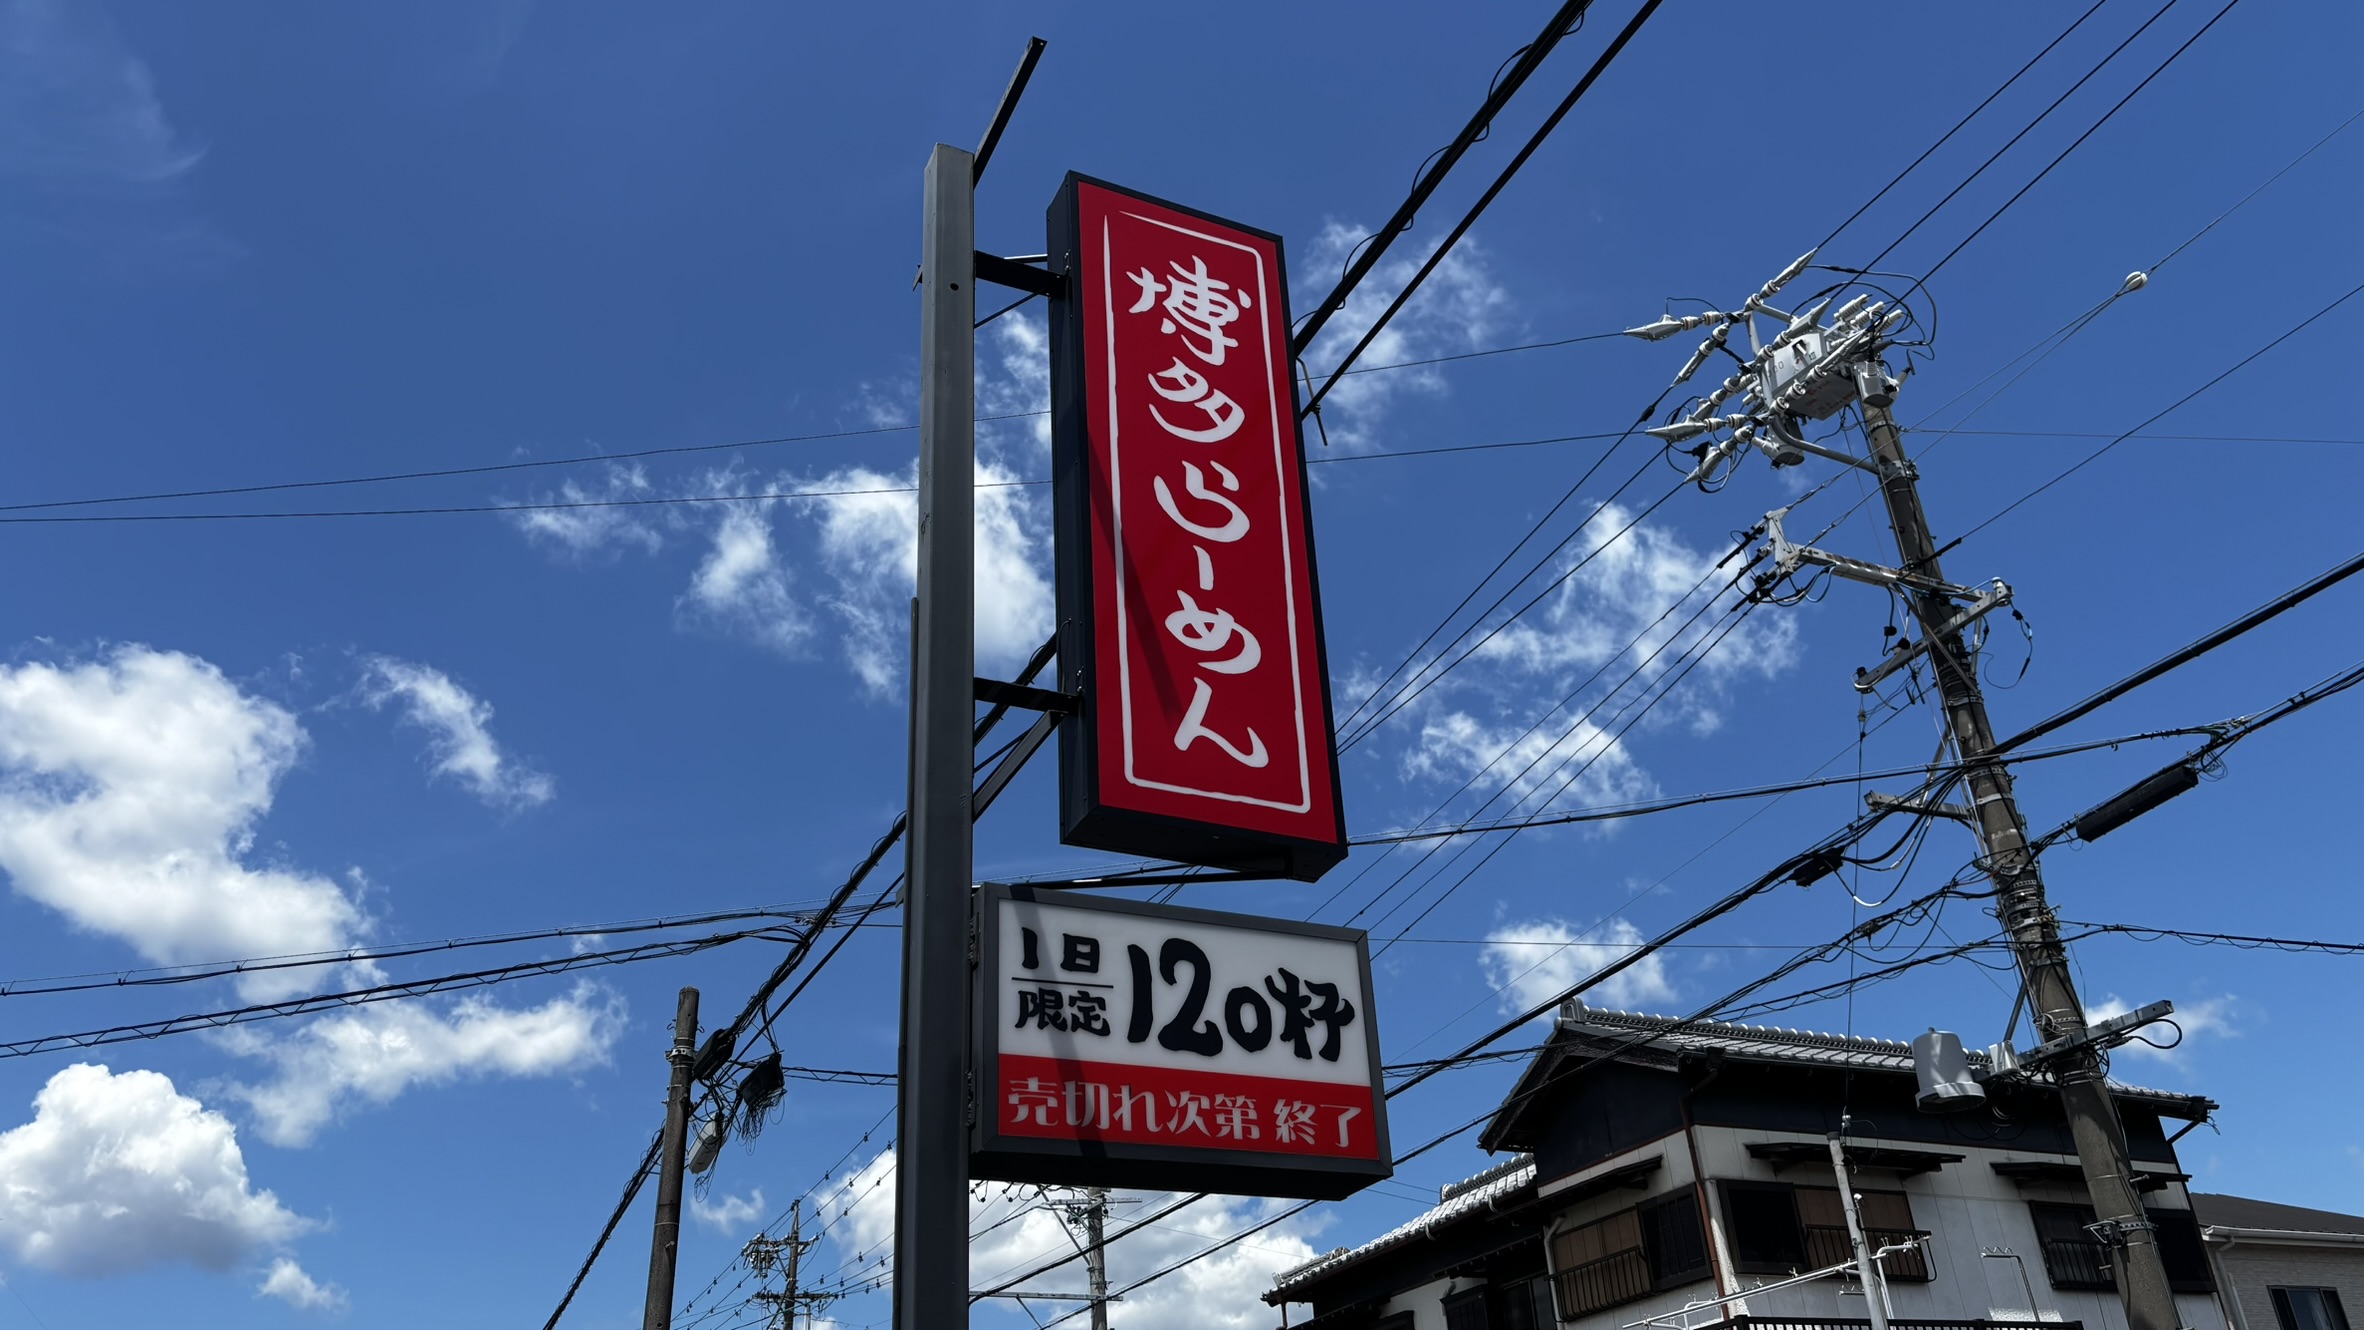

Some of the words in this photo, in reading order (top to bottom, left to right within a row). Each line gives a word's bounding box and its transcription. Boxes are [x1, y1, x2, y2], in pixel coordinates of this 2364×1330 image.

[1126, 255, 1269, 768] 博多らーめん
[1021, 926, 1101, 973] 1日
[1014, 989, 1111, 1036] 限定
